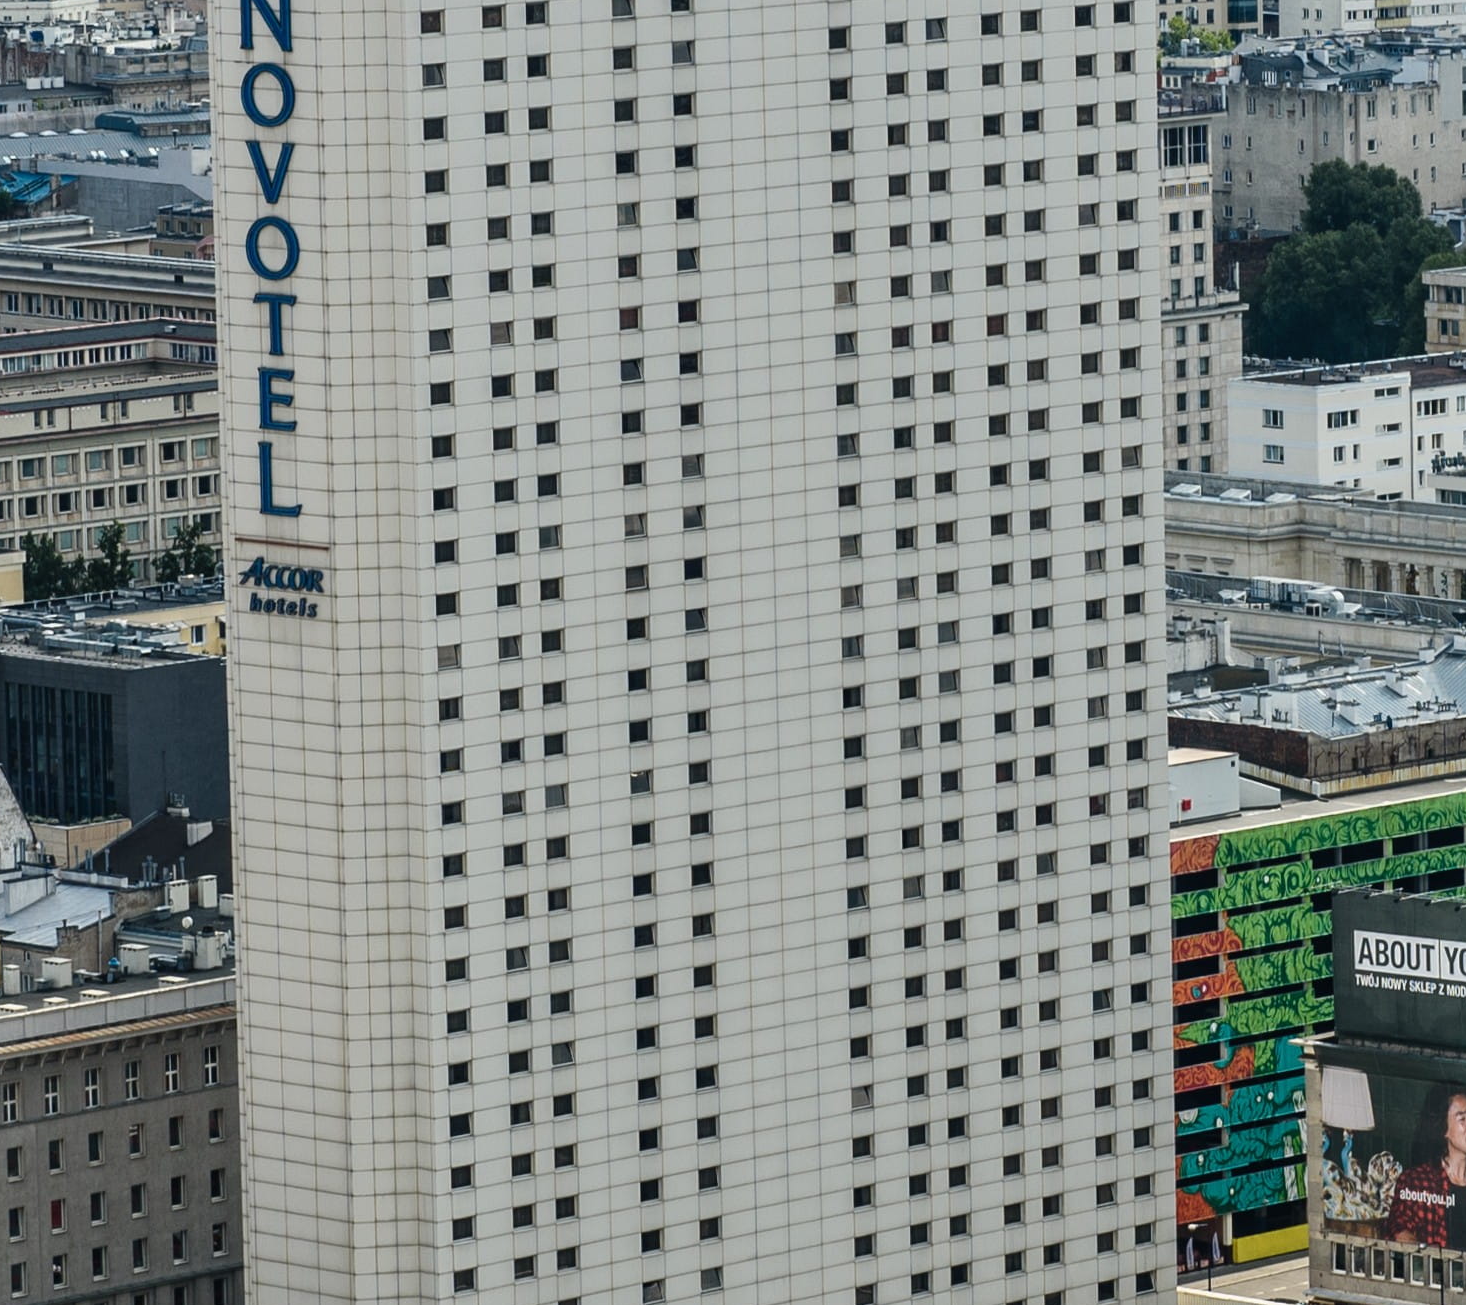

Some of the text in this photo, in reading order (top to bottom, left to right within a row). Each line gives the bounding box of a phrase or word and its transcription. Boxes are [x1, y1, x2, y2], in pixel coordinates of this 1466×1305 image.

[249, 590, 318, 619] hotels
[1358, 937, 1435, 972] ABOUT
[1355, 973, 1380, 988] TWÓJ
[1381, 977, 1407, 991] NOWY
[1409, 980, 1437, 994] SKLEP
[1438, 984, 1444, 995] Z
[1400, 1186, 1456, 1208] aboutyou.pl
